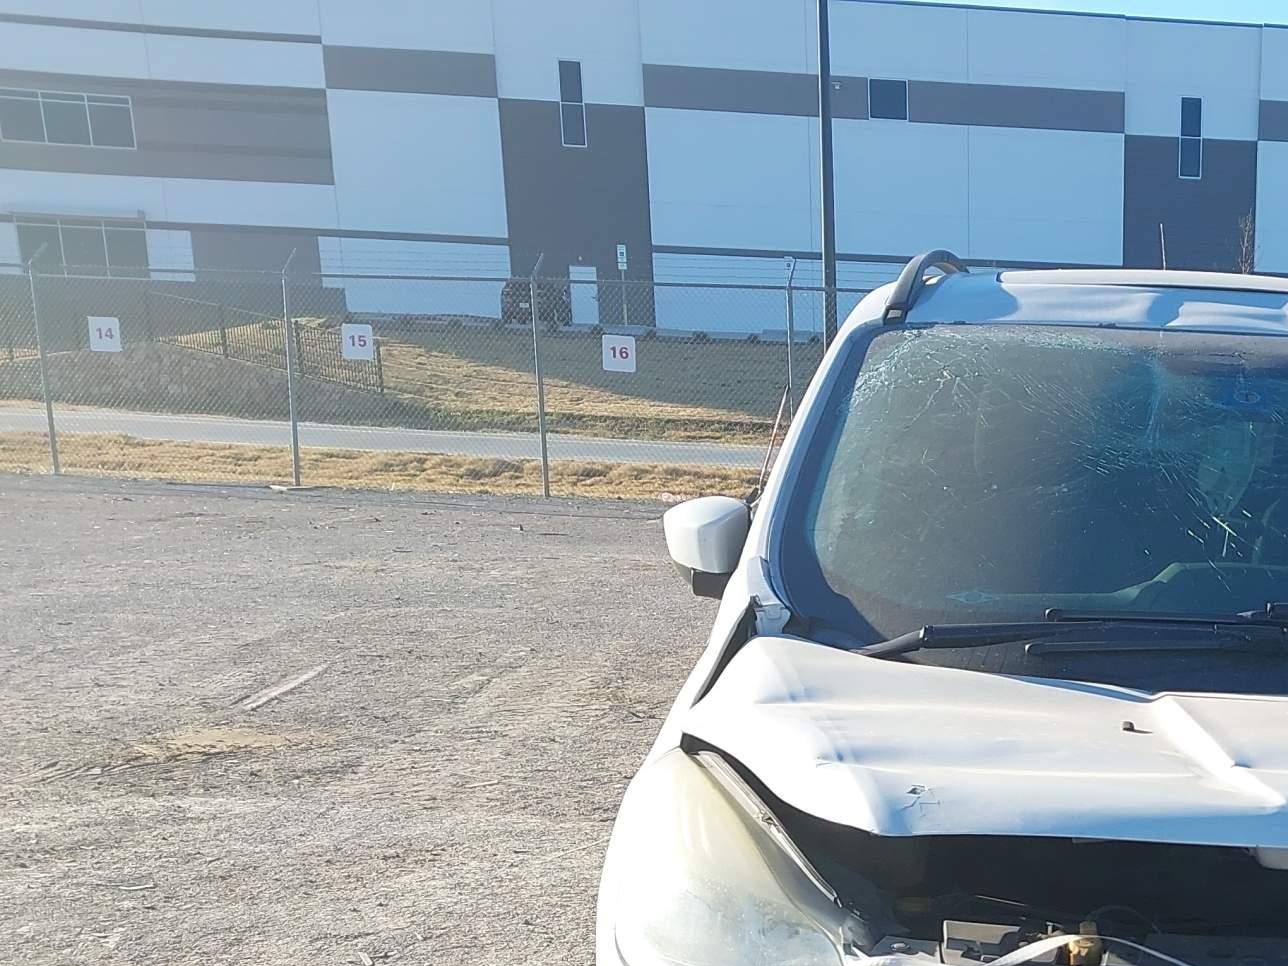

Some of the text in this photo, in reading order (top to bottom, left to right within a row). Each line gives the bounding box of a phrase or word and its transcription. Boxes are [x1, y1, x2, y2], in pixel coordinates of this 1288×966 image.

[95, 327, 114, 340] 14
[349, 334, 367, 347] 15
[609, 346, 629, 359] 16
